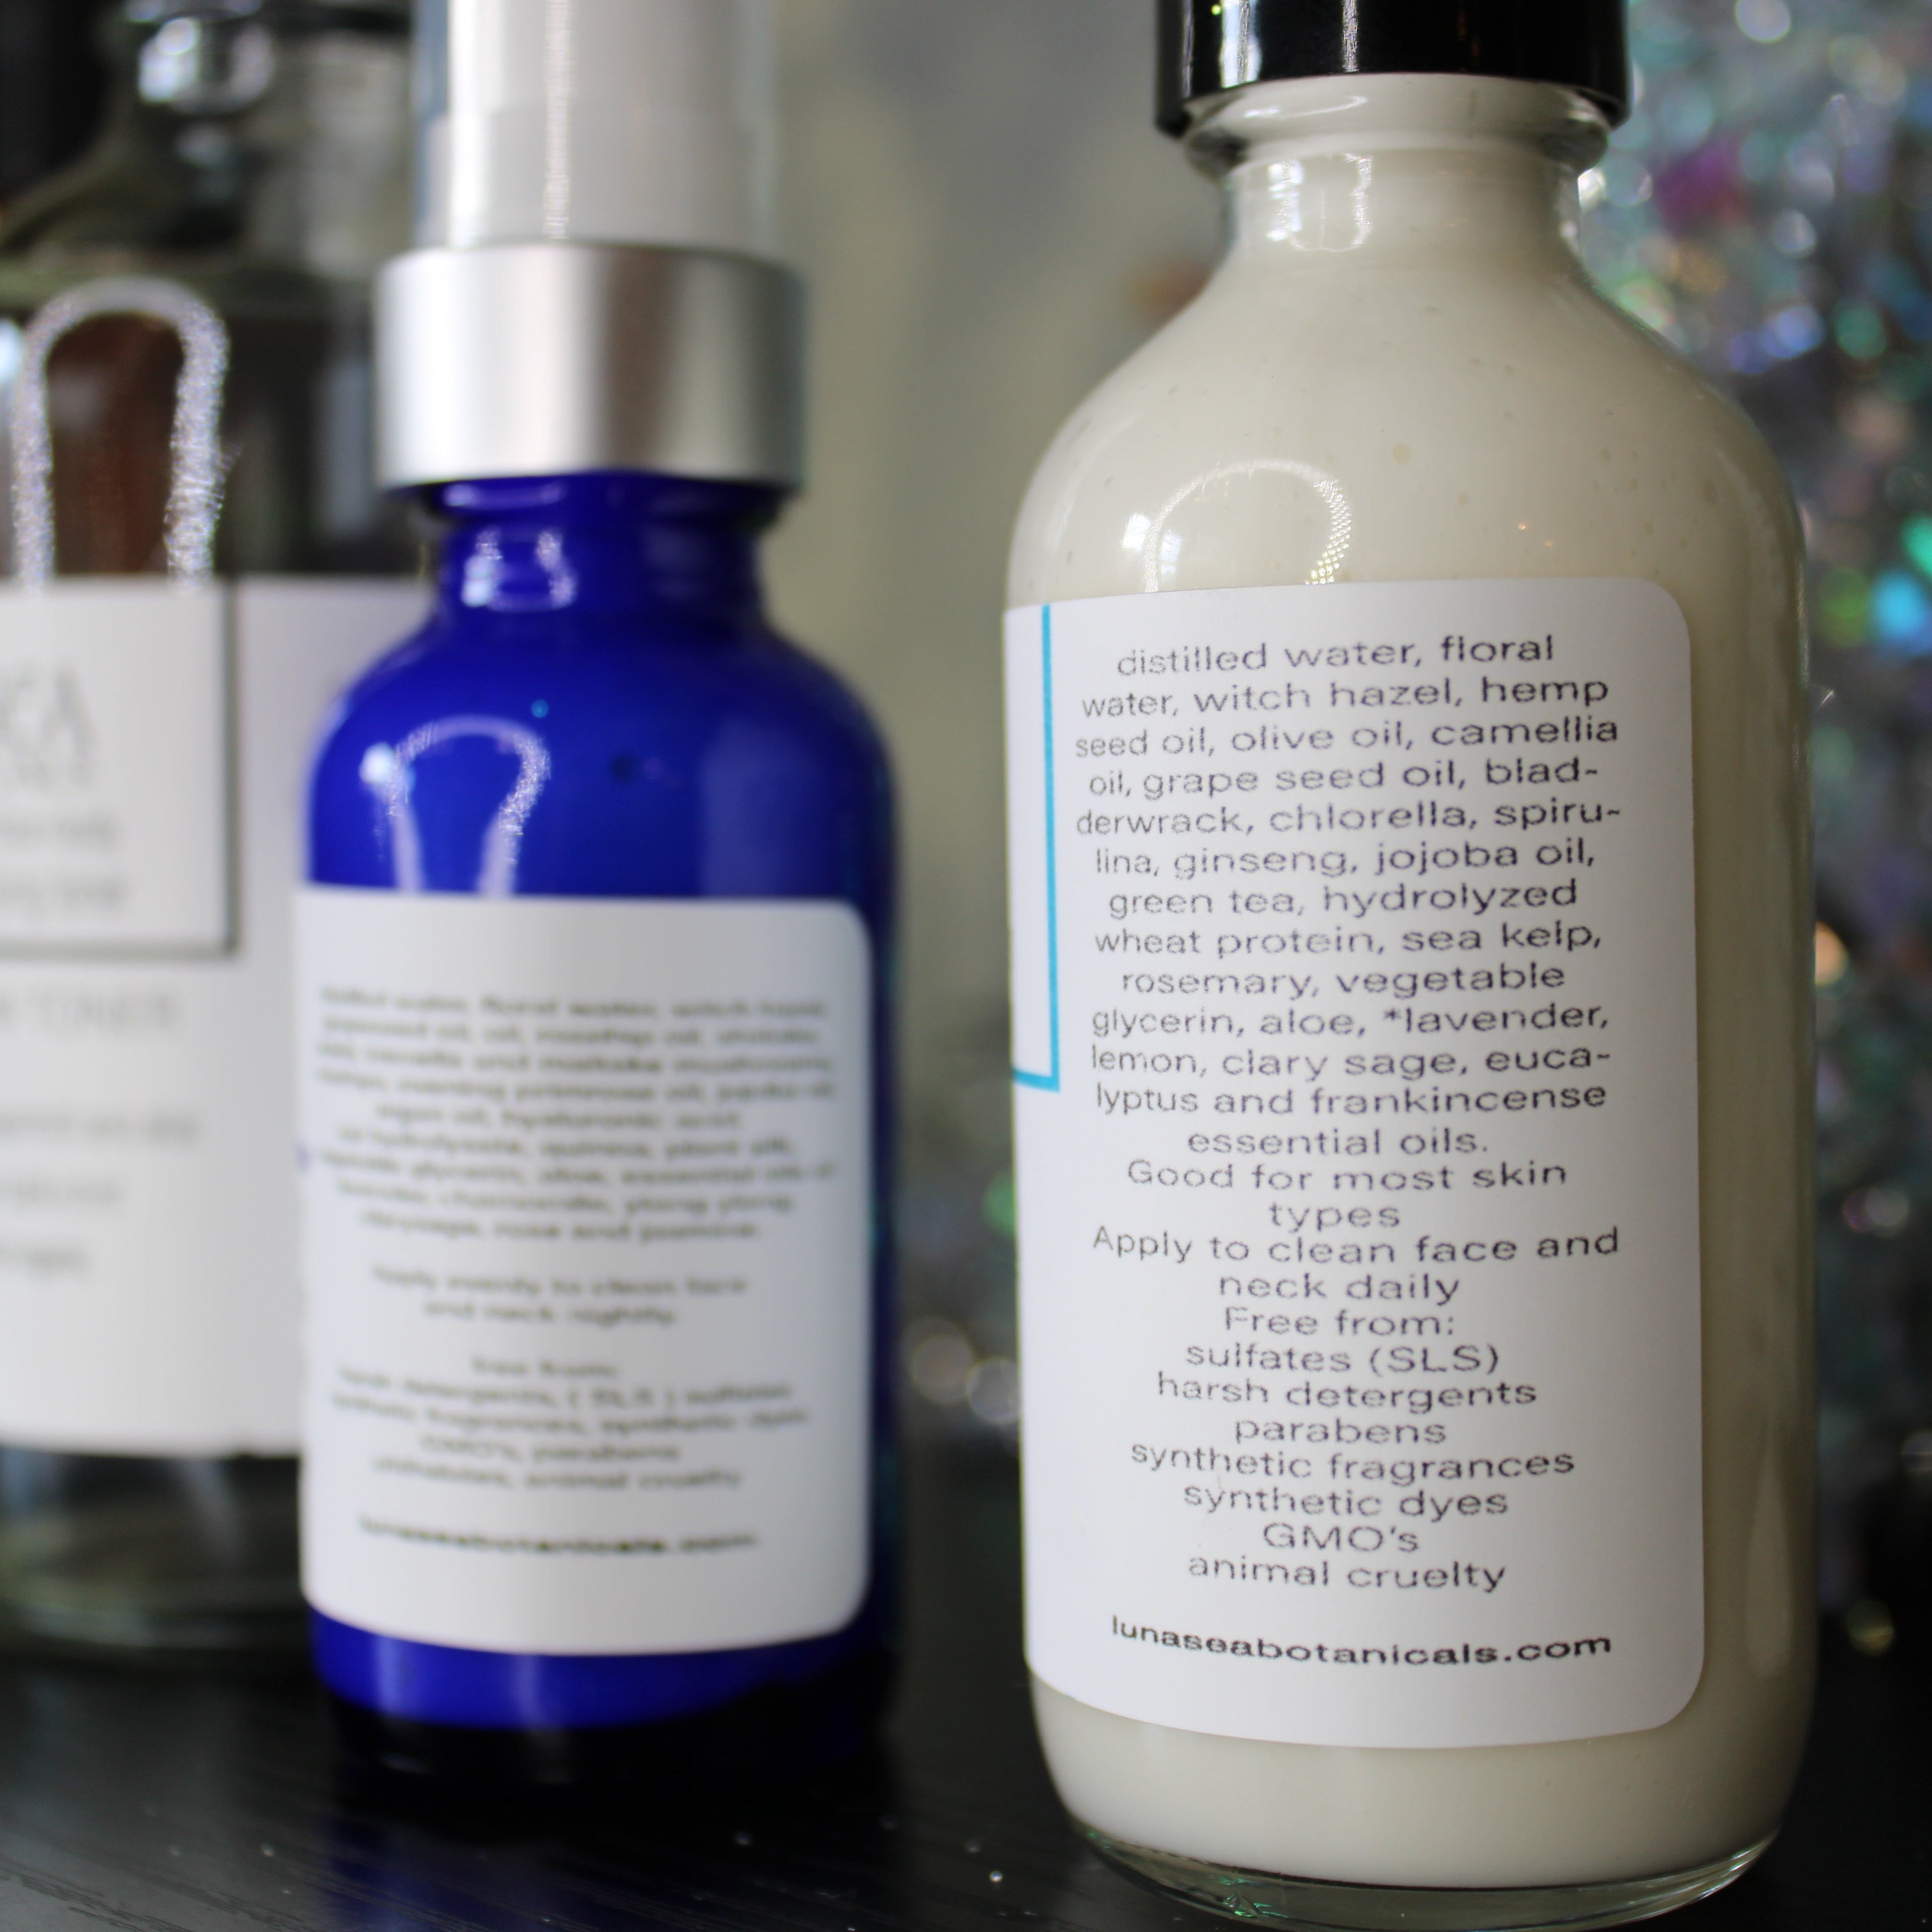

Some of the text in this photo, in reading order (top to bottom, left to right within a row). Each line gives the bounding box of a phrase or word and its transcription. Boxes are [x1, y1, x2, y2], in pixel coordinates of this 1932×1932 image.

[1116, 633, 1554, 677] distilled water, floral
[1082, 674, 1610, 718] water, witch hazel, hemp
[1076, 713, 1619, 758] seed oil, olive oil, camellia
[1088, 755, 1599, 801] oil, grape seed oil, blad-
[1076, 795, 1622, 836] derwrack, chlorella, spiru-
[1096, 835, 1596, 880] lina, ginseng, jojoba oil,
[1108, 876, 1578, 921] green tea, hydrolyzed
[1094, 918, 1602, 960] wheat protein, sea kelp,
[1121, 959, 1566, 1002] rosemary, vegetable
[1091, 1008, 1245, 1039] glycerin,
[1259, 1008, 1366, 1038] aloe,
[1091, 1043, 1612, 1083] lemon, clary sage, euca-
[1096, 1082, 1607, 1116] lyptus and frankincense
[1187, 1125, 1488, 1156] essential oils.
[1126, 1158, 1568, 1191] Good for most skin
[1268, 1202, 1401, 1234] types
[1092, 1224, 1620, 1265] Apply to clean face and
[1219, 1271, 1461, 1308] neck daily
[1224, 1306, 1454, 1337] Free from:
[1186, 1341, 1500, 1377] sulfates (SLS)
[1157, 1370, 1538, 1416] harsh detergents
[1234, 1416, 1447, 1445] parabens
[1131, 1443, 1576, 1488] synthetic fragrances
[1183, 1485, 1509, 1524] synthetic dyes
[1262, 1521, 1420, 1554] GMO's
[1188, 1557, 1506, 1595] animal cruelty
[1111, 1615, 1613, 1667] lunaseabotanicals.com
